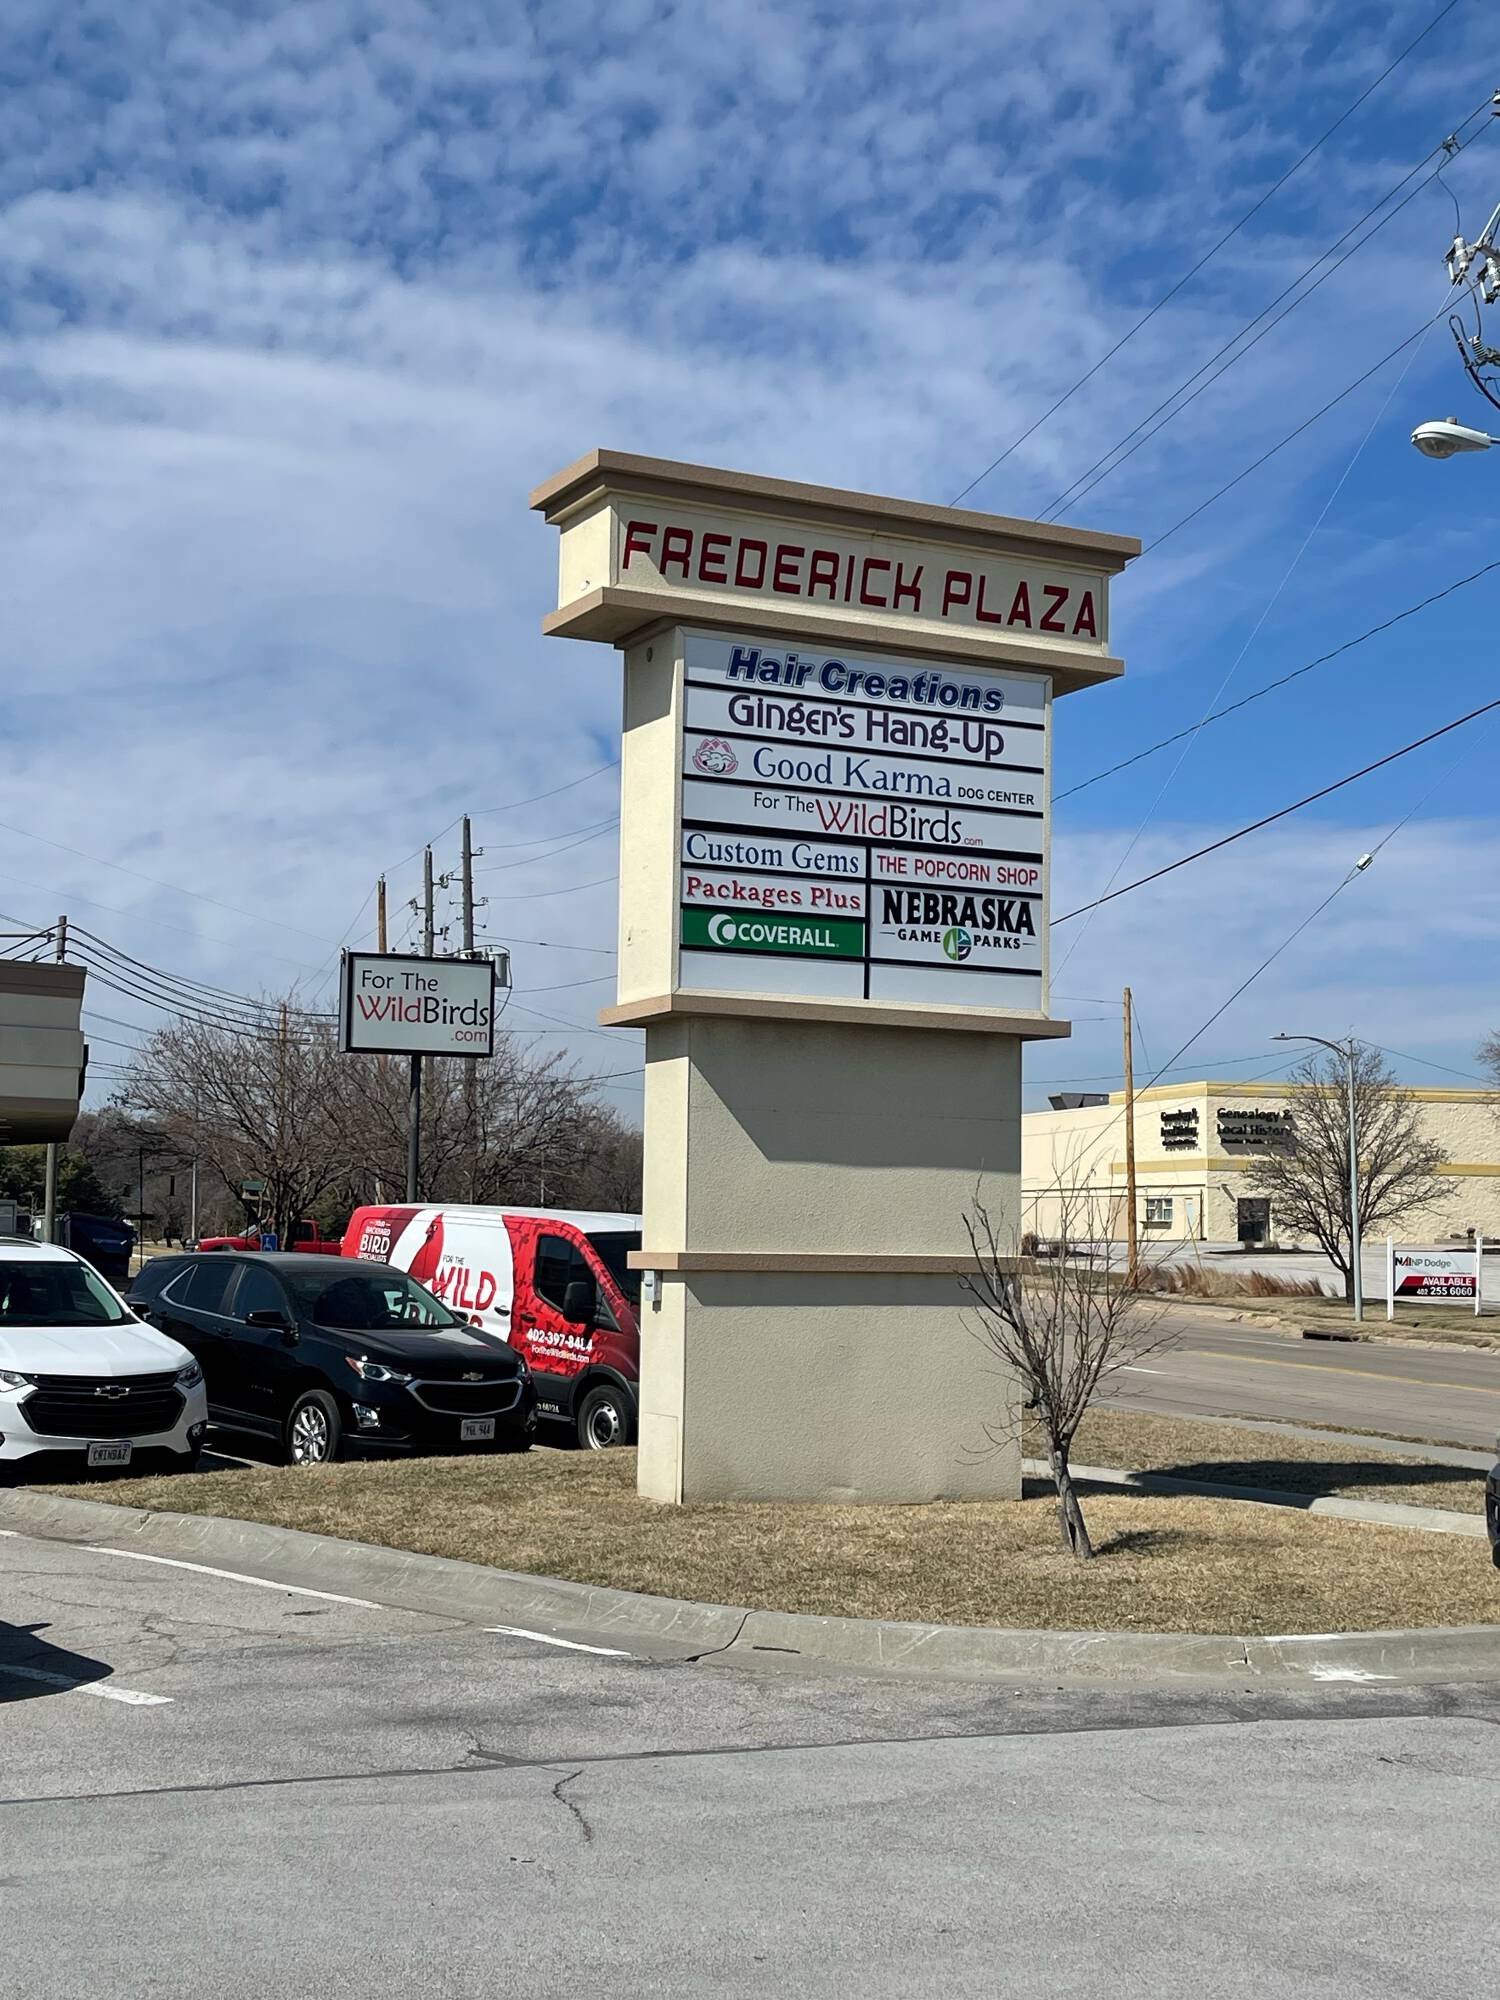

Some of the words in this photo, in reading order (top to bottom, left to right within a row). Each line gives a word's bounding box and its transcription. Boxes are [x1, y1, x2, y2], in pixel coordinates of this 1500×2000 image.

[622, 520, 924, 613] FREDERICK
[941, 569, 1097, 638] PLAZA
[726, 646, 815, 688] Hair
[819, 659, 1004, 714] Creations
[728, 694, 855, 738] Ginger's
[866, 710, 1005, 761] Hang-Up
[753, 747, 832, 785] Good
[843, 756, 952, 798] Karma
[957, 786, 984, 800] DOG
[987, 789, 1035, 806] CENTER
[754, 791, 780, 810] For
[785, 795, 815, 813] The
[686, 833, 783, 867] Custom
[791, 843, 859, 874] Gems
[876, 854, 908, 874] THE
[914, 858, 991, 883] POPCORN
[997, 866, 1039, 887] SHOP
[686, 876, 802, 908] Packages
[810, 886, 862, 910] Plus
[882, 888, 1036, 937] NEBRASKA
[737, 923, 836, 948] COVERALL
[897, 928, 942, 944] GAME
[973, 934, 1021, 950] PARKS
[362, 970, 394, 989] For
[401, 972, 439, 992] The
[356, 994, 489, 1027] WildBirds
[450, 1030, 488, 1043] .com
[1216, 1107, 1280, 1123] Genealogy
[1216, 1123, 1248, 1136] Local
[1250, 1123, 1293, 1138] History
[359, 1233, 391, 1255] BIRD
[1424, 1258, 1452, 1269] Dodge
[432, 1266, 497, 1311] WILD
[1422, 1277, 1473, 1286] AVAILABLE
[1430, 1286, 1448, 1296] 255
[1449, 1287, 1473, 1296] 6060
